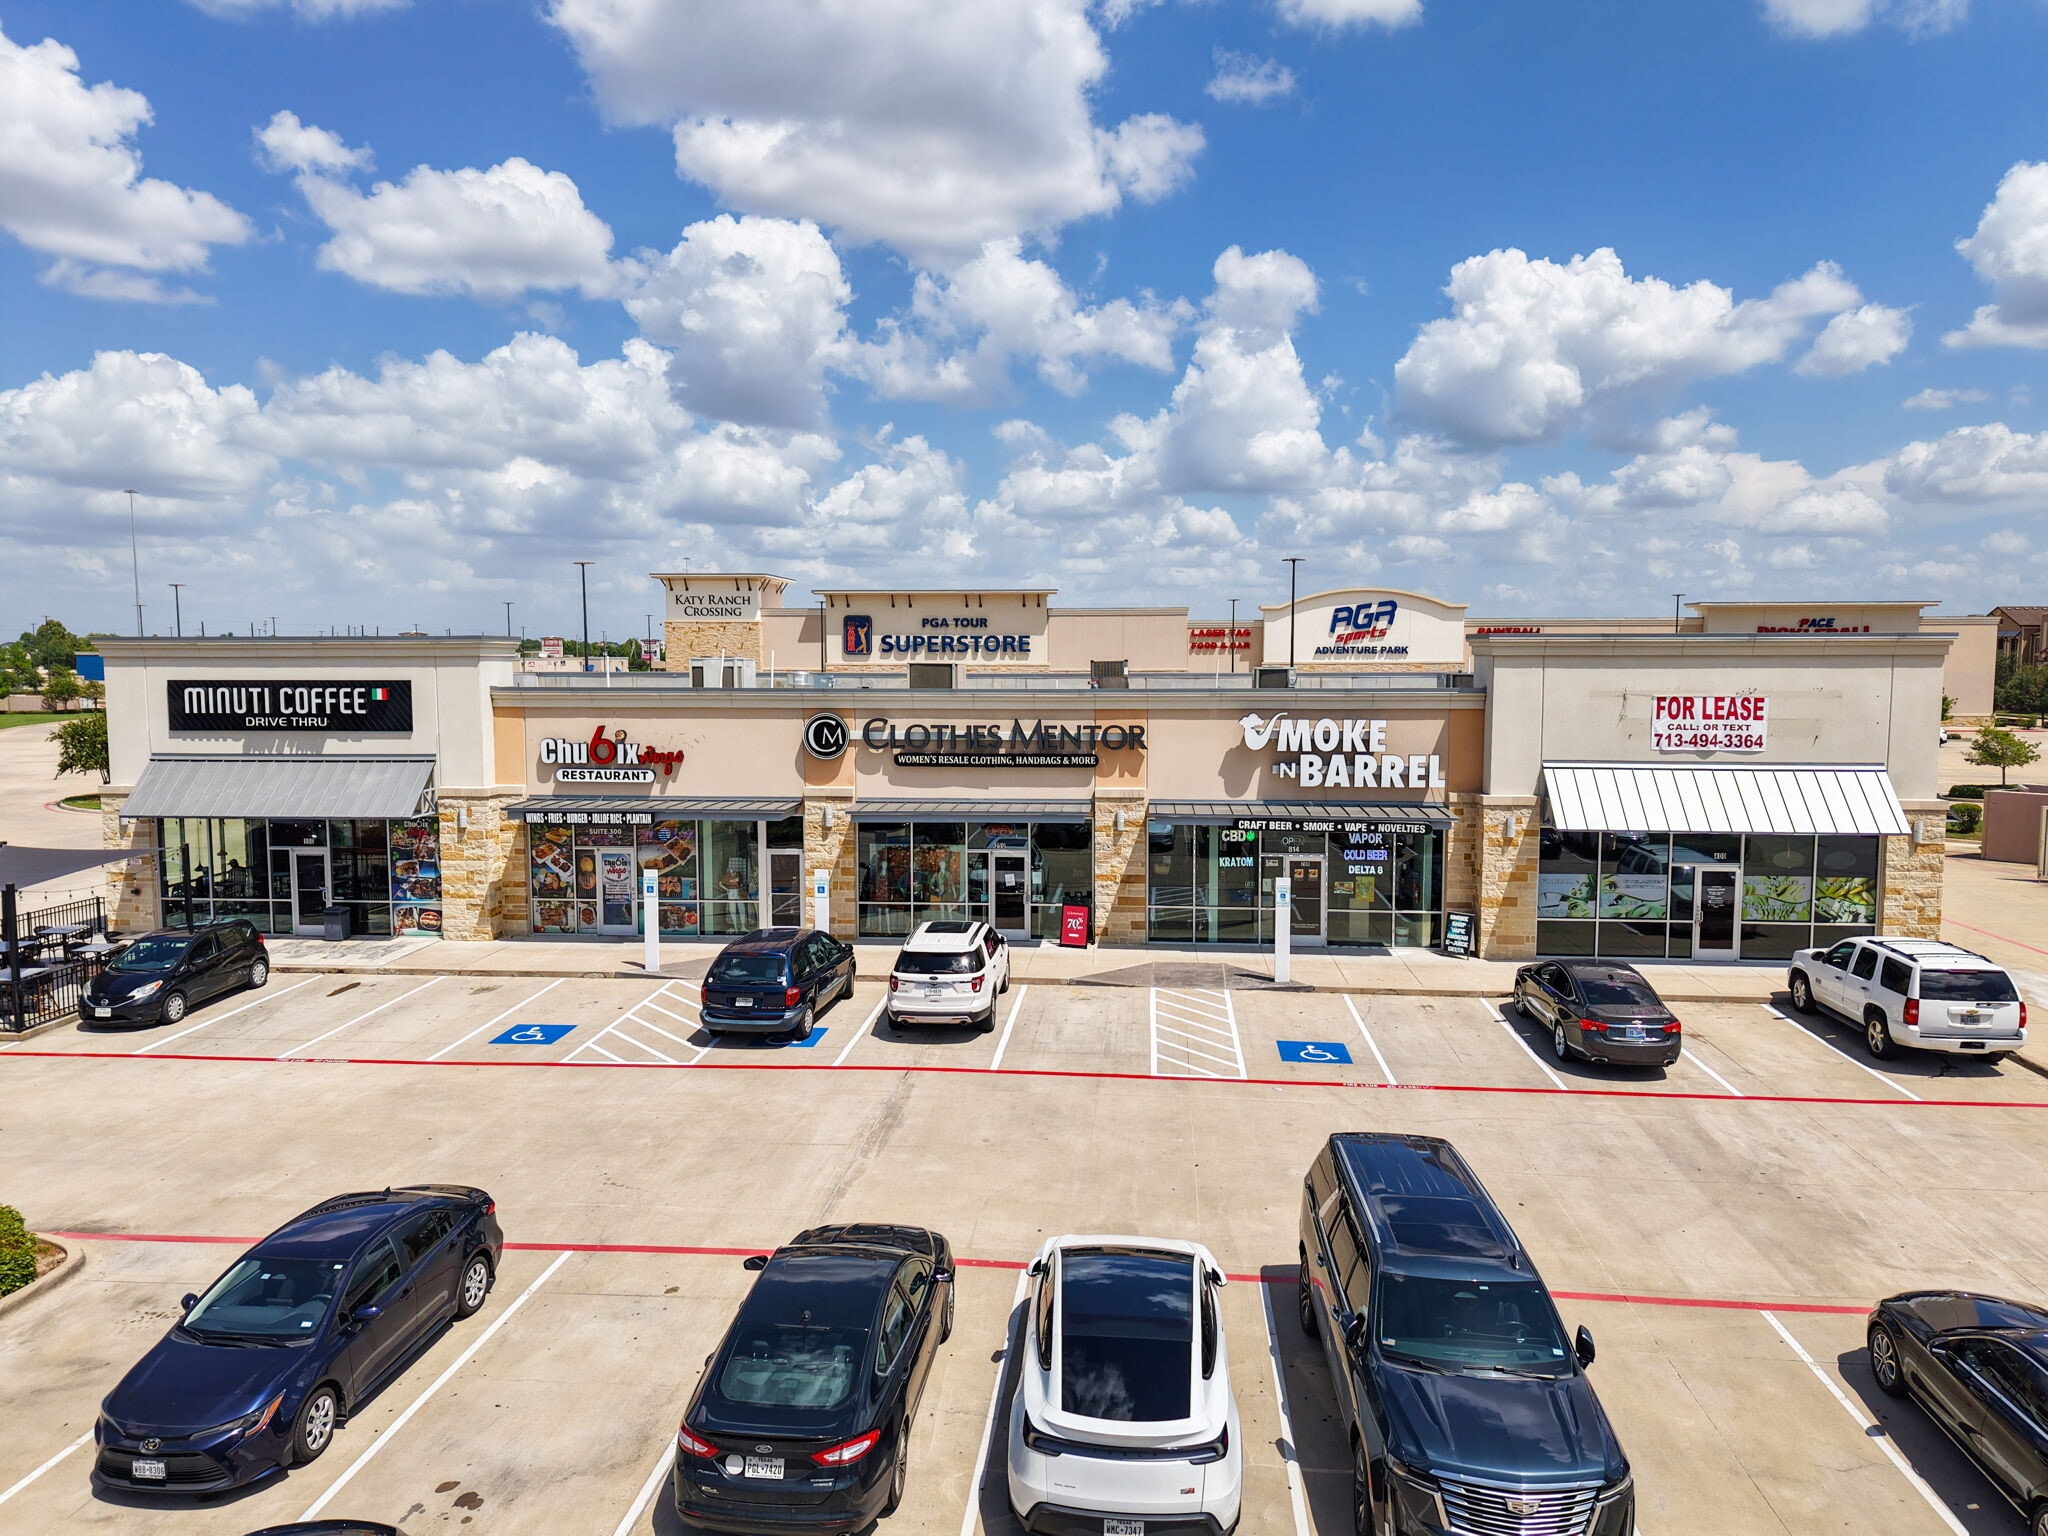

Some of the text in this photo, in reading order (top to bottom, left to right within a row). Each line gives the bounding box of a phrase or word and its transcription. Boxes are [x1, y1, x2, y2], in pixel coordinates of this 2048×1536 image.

[675, 594, 751, 606] KATY RANCH
[684, 606, 742, 618] CROSSING
[922, 618, 988, 628] PGA TOUR
[1799, 618, 1835, 628] PACE
[1336, 626, 1390, 645] sports
[880, 634, 1032, 654] SUPERSTORE
[1315, 646, 1409, 656] ADVENTURE PARK
[184, 687, 366, 714] MINUTI COFFEE
[1656, 696, 1765, 721] FOR LEASE
[246, 717, 328, 727] DRIVE THRU
[1722, 723, 1751, 732] TEXT
[862, 718, 1148, 750] CLOTHES MENTOR
[1654, 733, 1763, 748] 713-494-3364
[898, 754, 1096, 766] WOMEN'S RESALE CLOTHING, HANDBAGS & MORE
[562, 770, 649, 781] RESTAURANT
[1279, 754, 1446, 788] N BARREL
[526, 813, 544, 823] WINGS
[548, 813, 563, 823] FRIES
[567, 813, 588, 824] BURGER
[610, 813, 622, 824] RICE
[626, 814, 652, 824] PLANTAIN
[1238, 820, 1426, 834] CRAFT BEER SMOKE VAPE NOVELTIES
[1222, 830, 1246, 842] CBD
[1349, 833, 1382, 844] VAPOR
[1344, 850, 1387, 860] COLD BEER
[1219, 857, 1254, 867] KRATOM
[1348, 865, 1383, 874] DELTA 8
